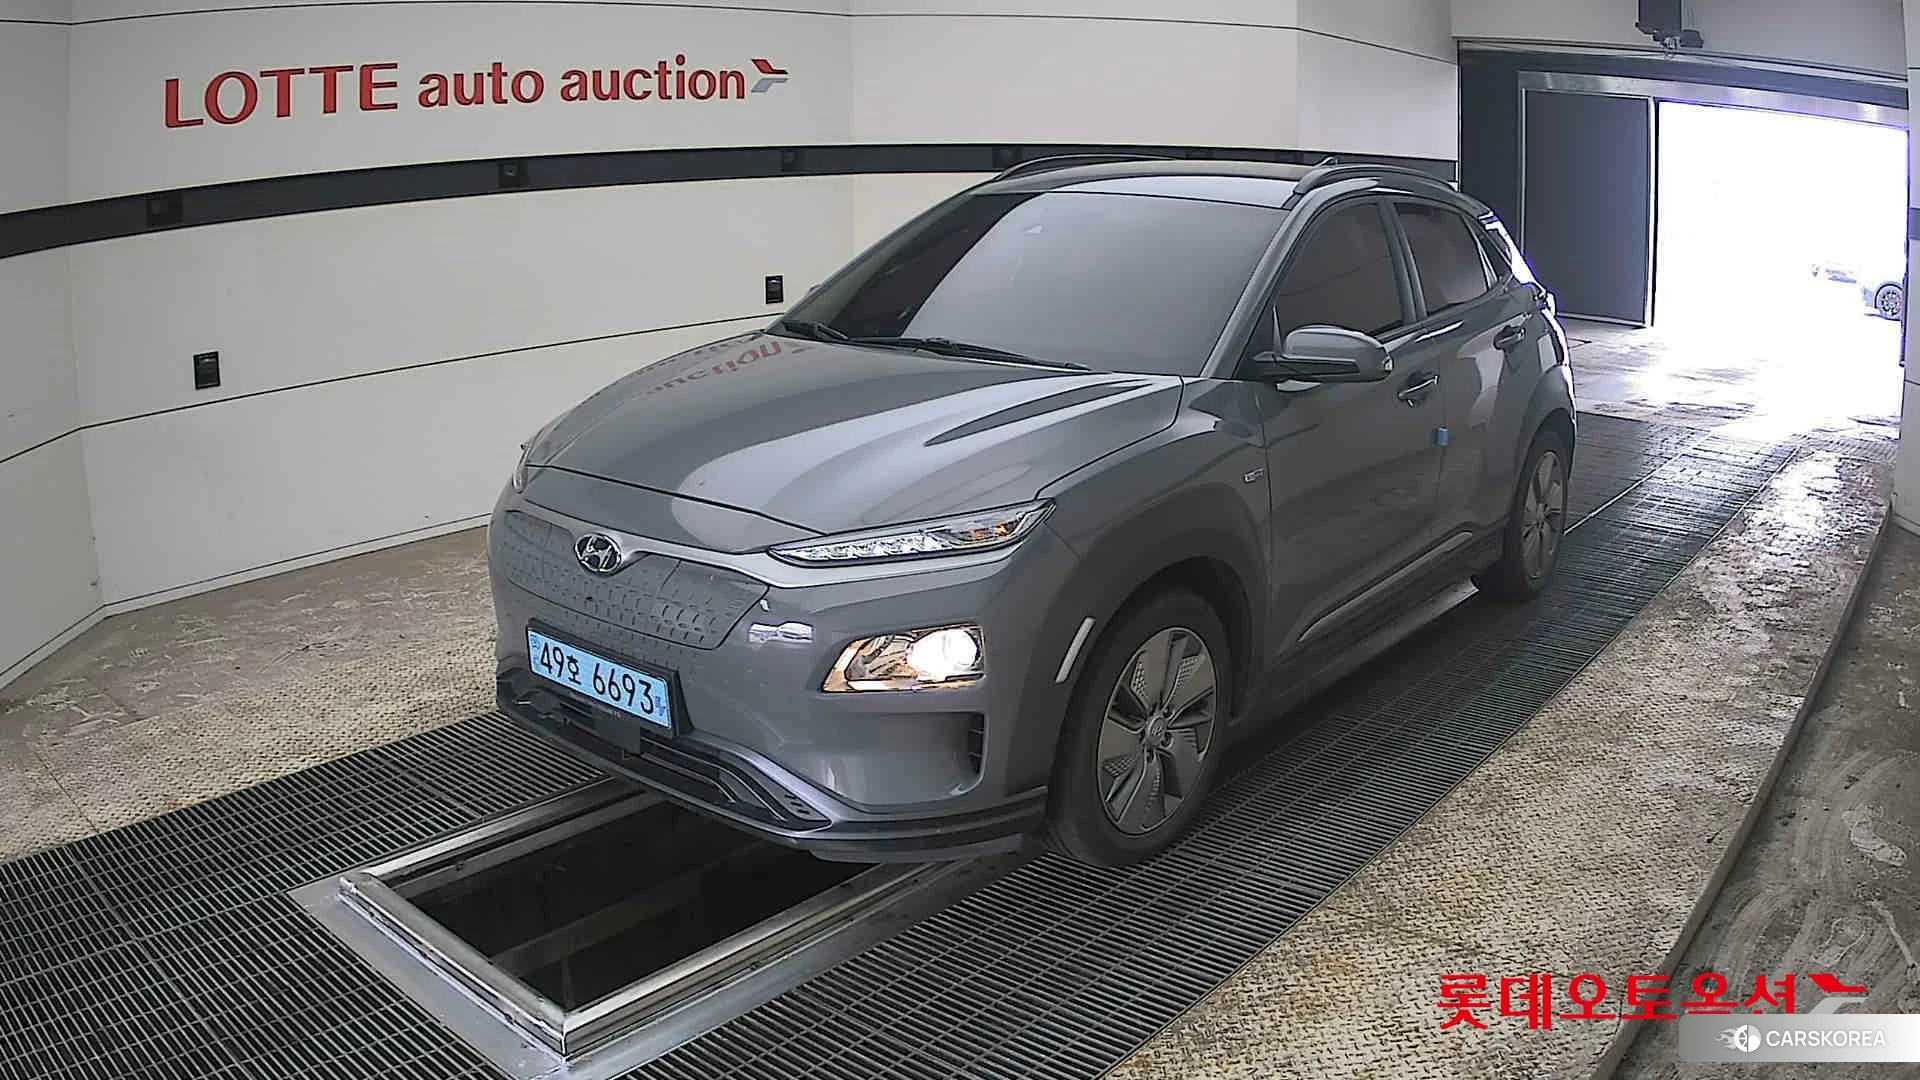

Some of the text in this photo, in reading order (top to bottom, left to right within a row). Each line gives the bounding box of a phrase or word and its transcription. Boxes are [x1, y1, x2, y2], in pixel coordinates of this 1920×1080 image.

[164, 54, 746, 128] LOTTE auto auction
[540, 641, 582, 686] 49호
[592, 662, 655, 715] 6693
